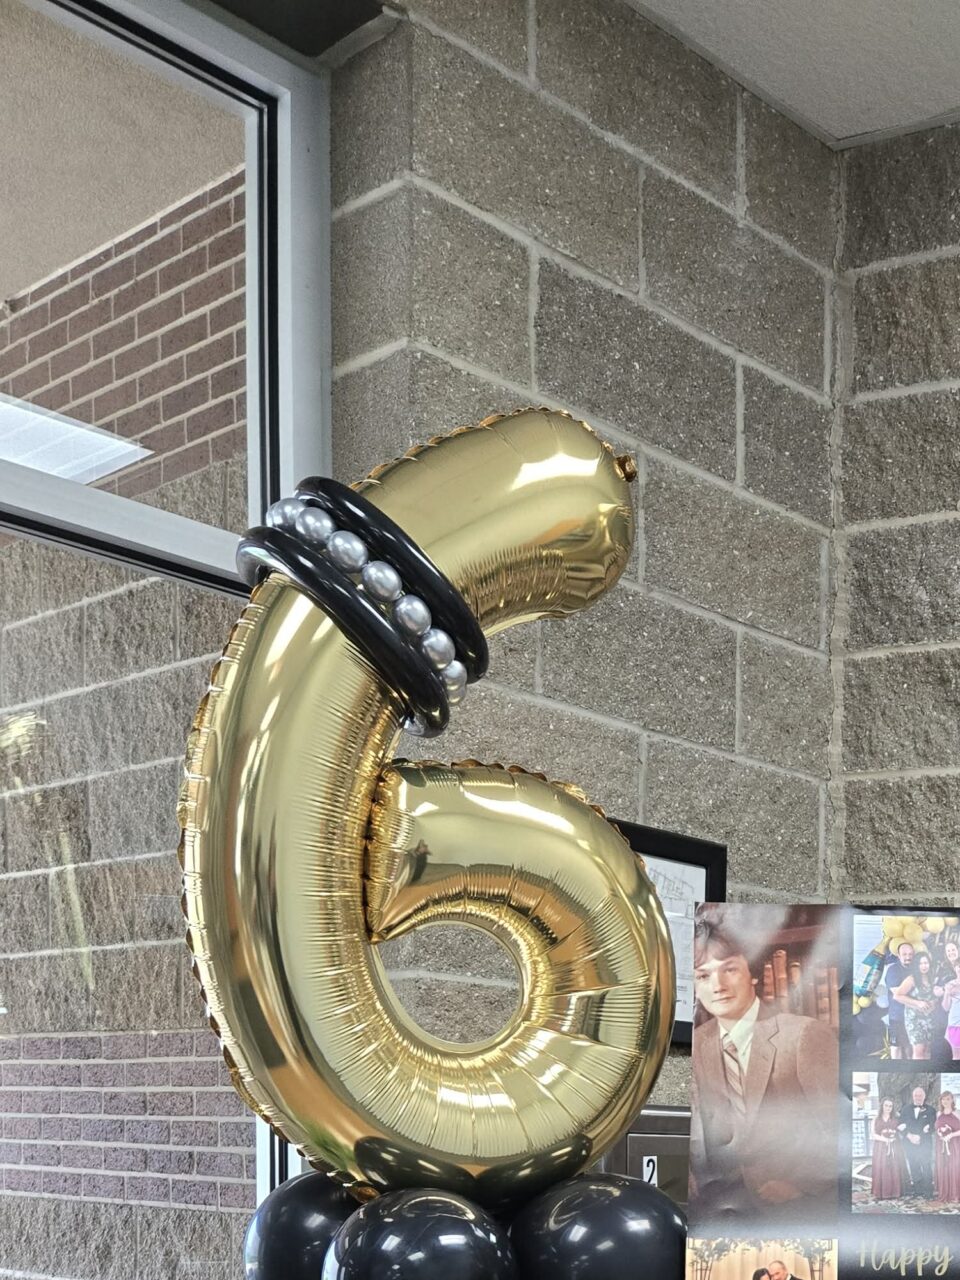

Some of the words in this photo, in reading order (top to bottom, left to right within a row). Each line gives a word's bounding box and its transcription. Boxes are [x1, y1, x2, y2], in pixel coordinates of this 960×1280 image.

[177, 406, 675, 1200] 6
[646, 1158, 656, 1184] 2
[856, 1239, 953, 1277] Happy
